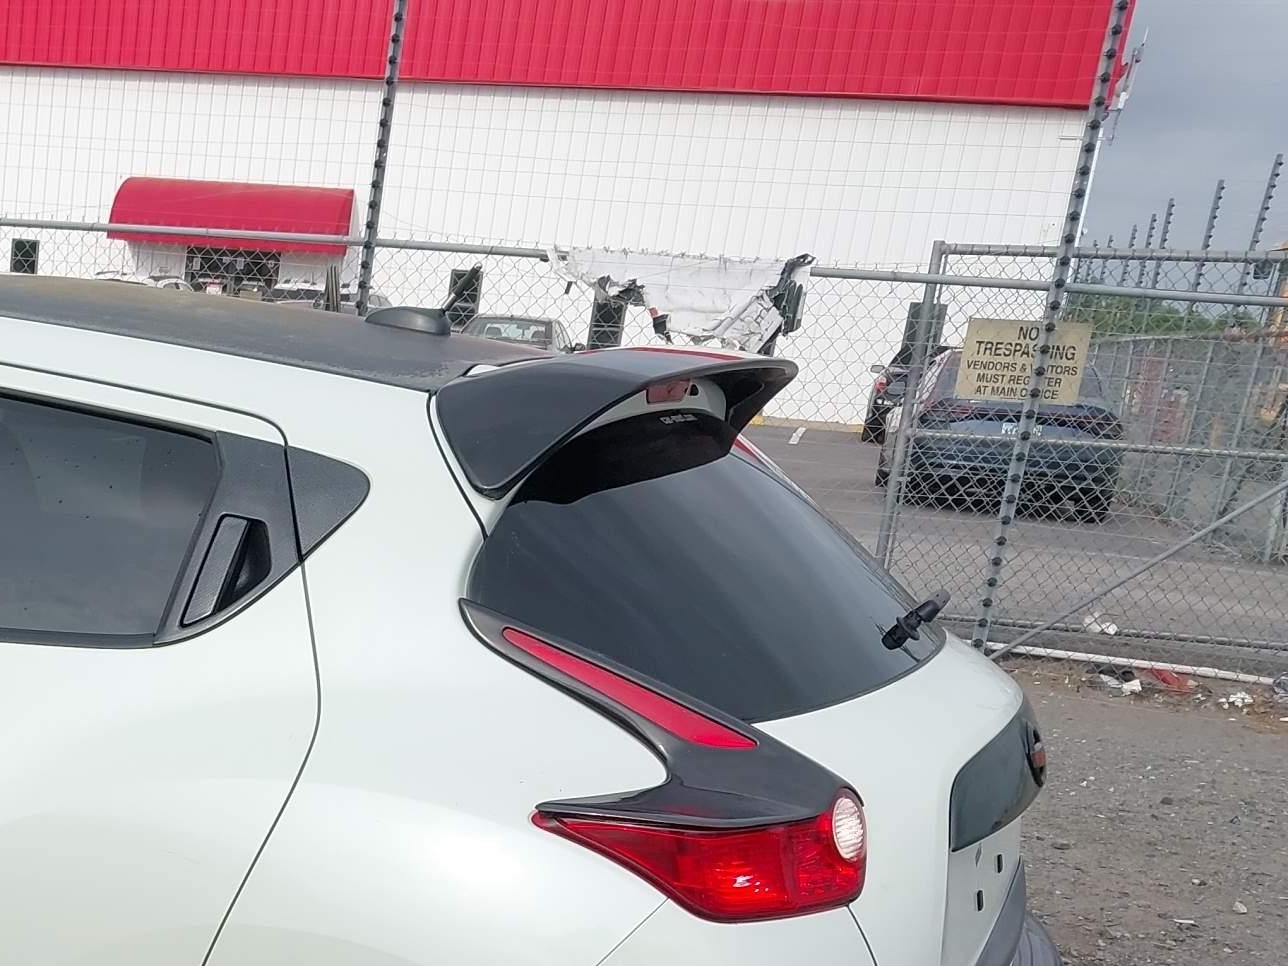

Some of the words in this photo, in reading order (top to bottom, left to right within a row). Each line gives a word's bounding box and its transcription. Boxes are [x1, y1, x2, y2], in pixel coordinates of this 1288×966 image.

[1017, 326, 1040, 340] NO
[975, 340, 1077, 361] TRESPASING
[966, 359, 1017, 373] VENDORS
[1019, 363, 1027, 373] &
[976, 373, 1006, 385] MUST
[974, 385, 989, 395] AT
[991, 386, 1017, 398] MAIN
[1019, 388, 1059, 400] OICE
